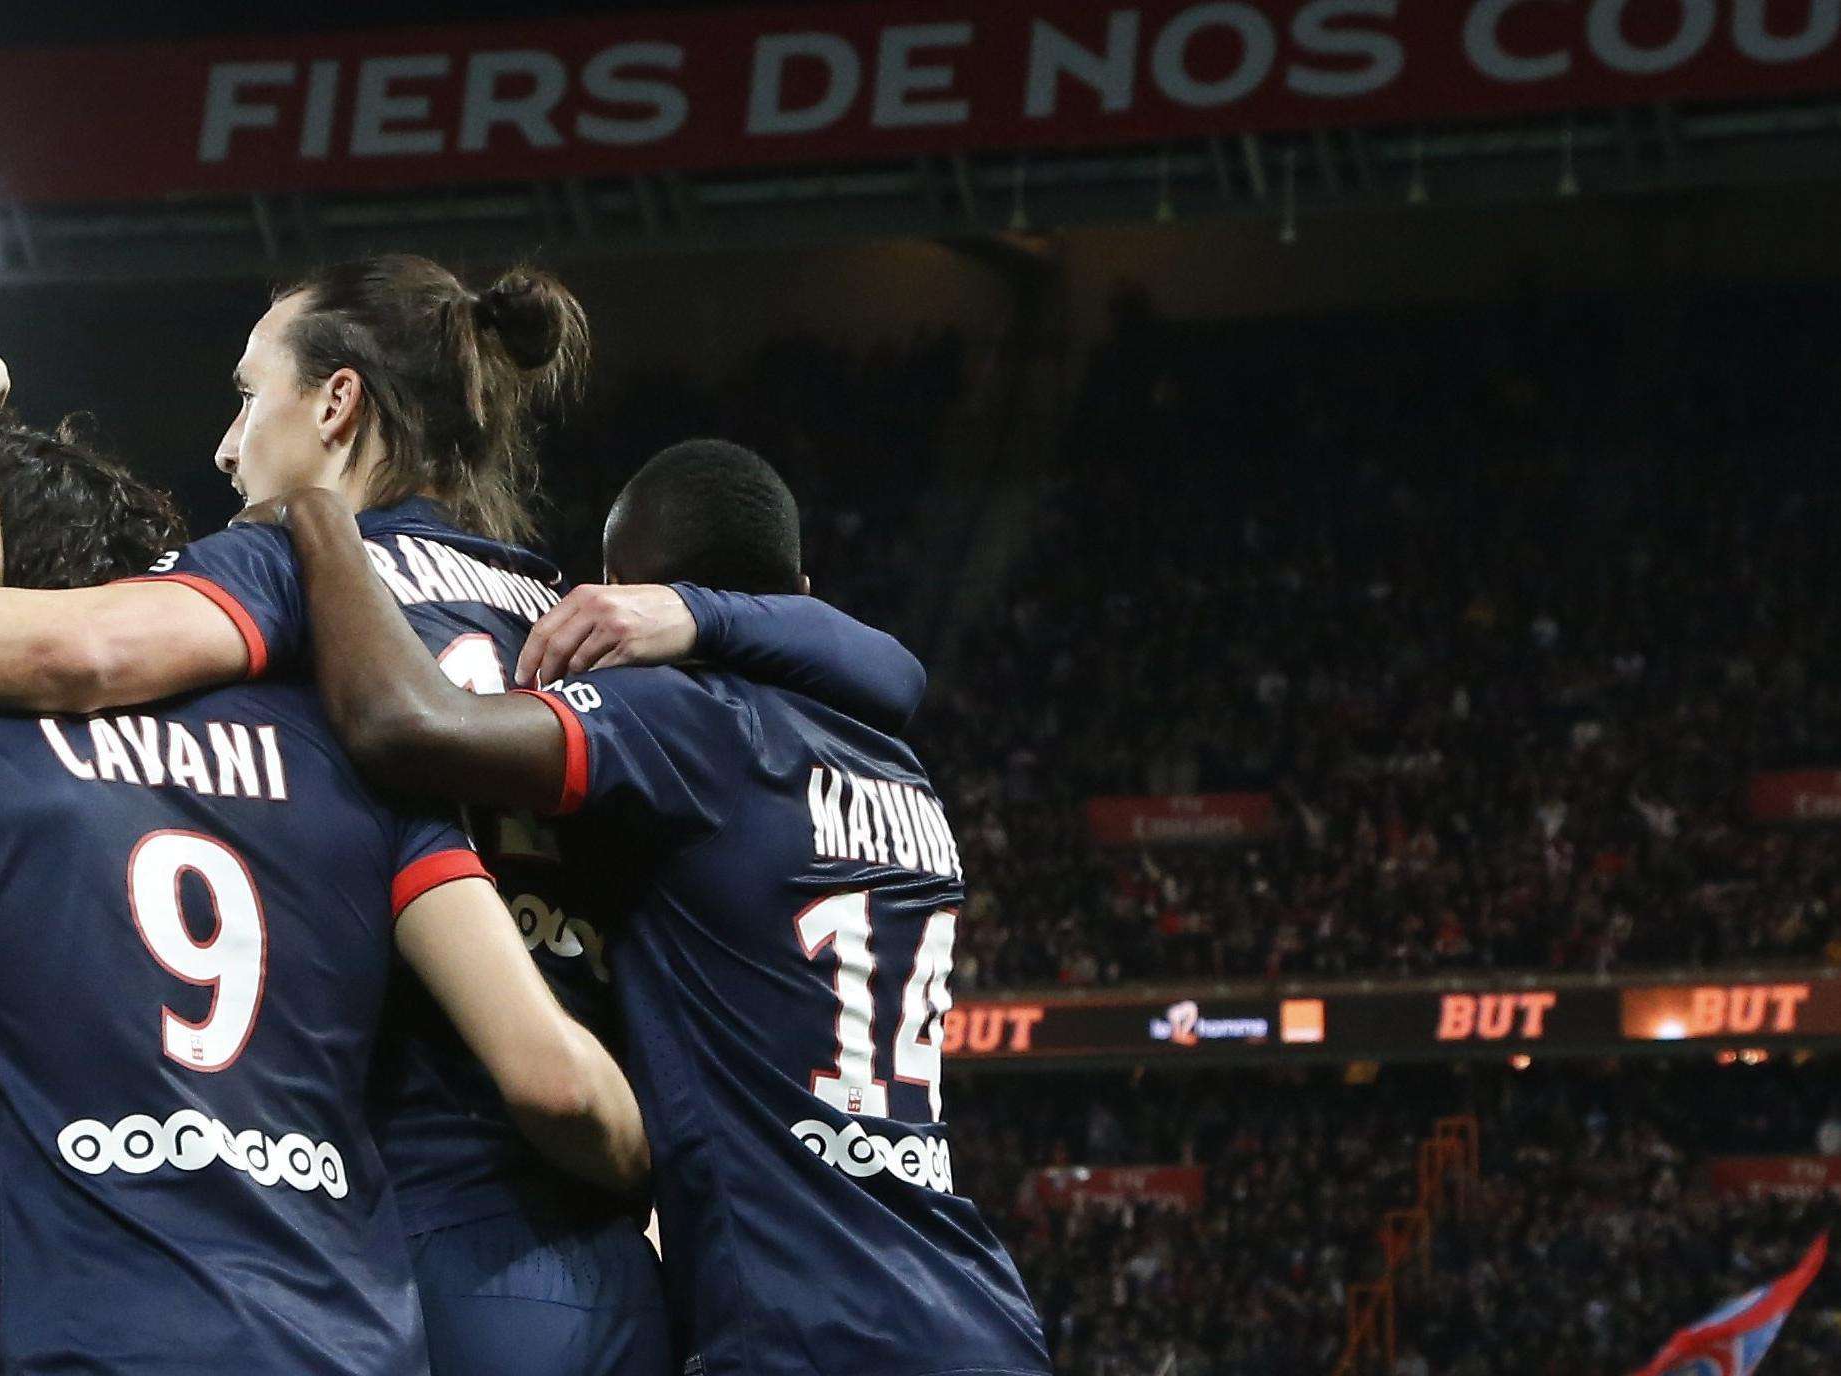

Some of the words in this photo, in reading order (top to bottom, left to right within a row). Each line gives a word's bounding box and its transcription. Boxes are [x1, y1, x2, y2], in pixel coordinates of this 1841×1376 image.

[197, 40, 690, 162] FIERS
[745, 22, 974, 135] DE
[1023, 0, 1405, 119] NOS
[127, 828, 268, 1073] 9
[793, 889, 958, 1122] 14
[944, 1004, 1045, 1052] BUT
[1437, 991, 1557, 1041] BUT
[1691, 983, 1811, 1034] BUT
